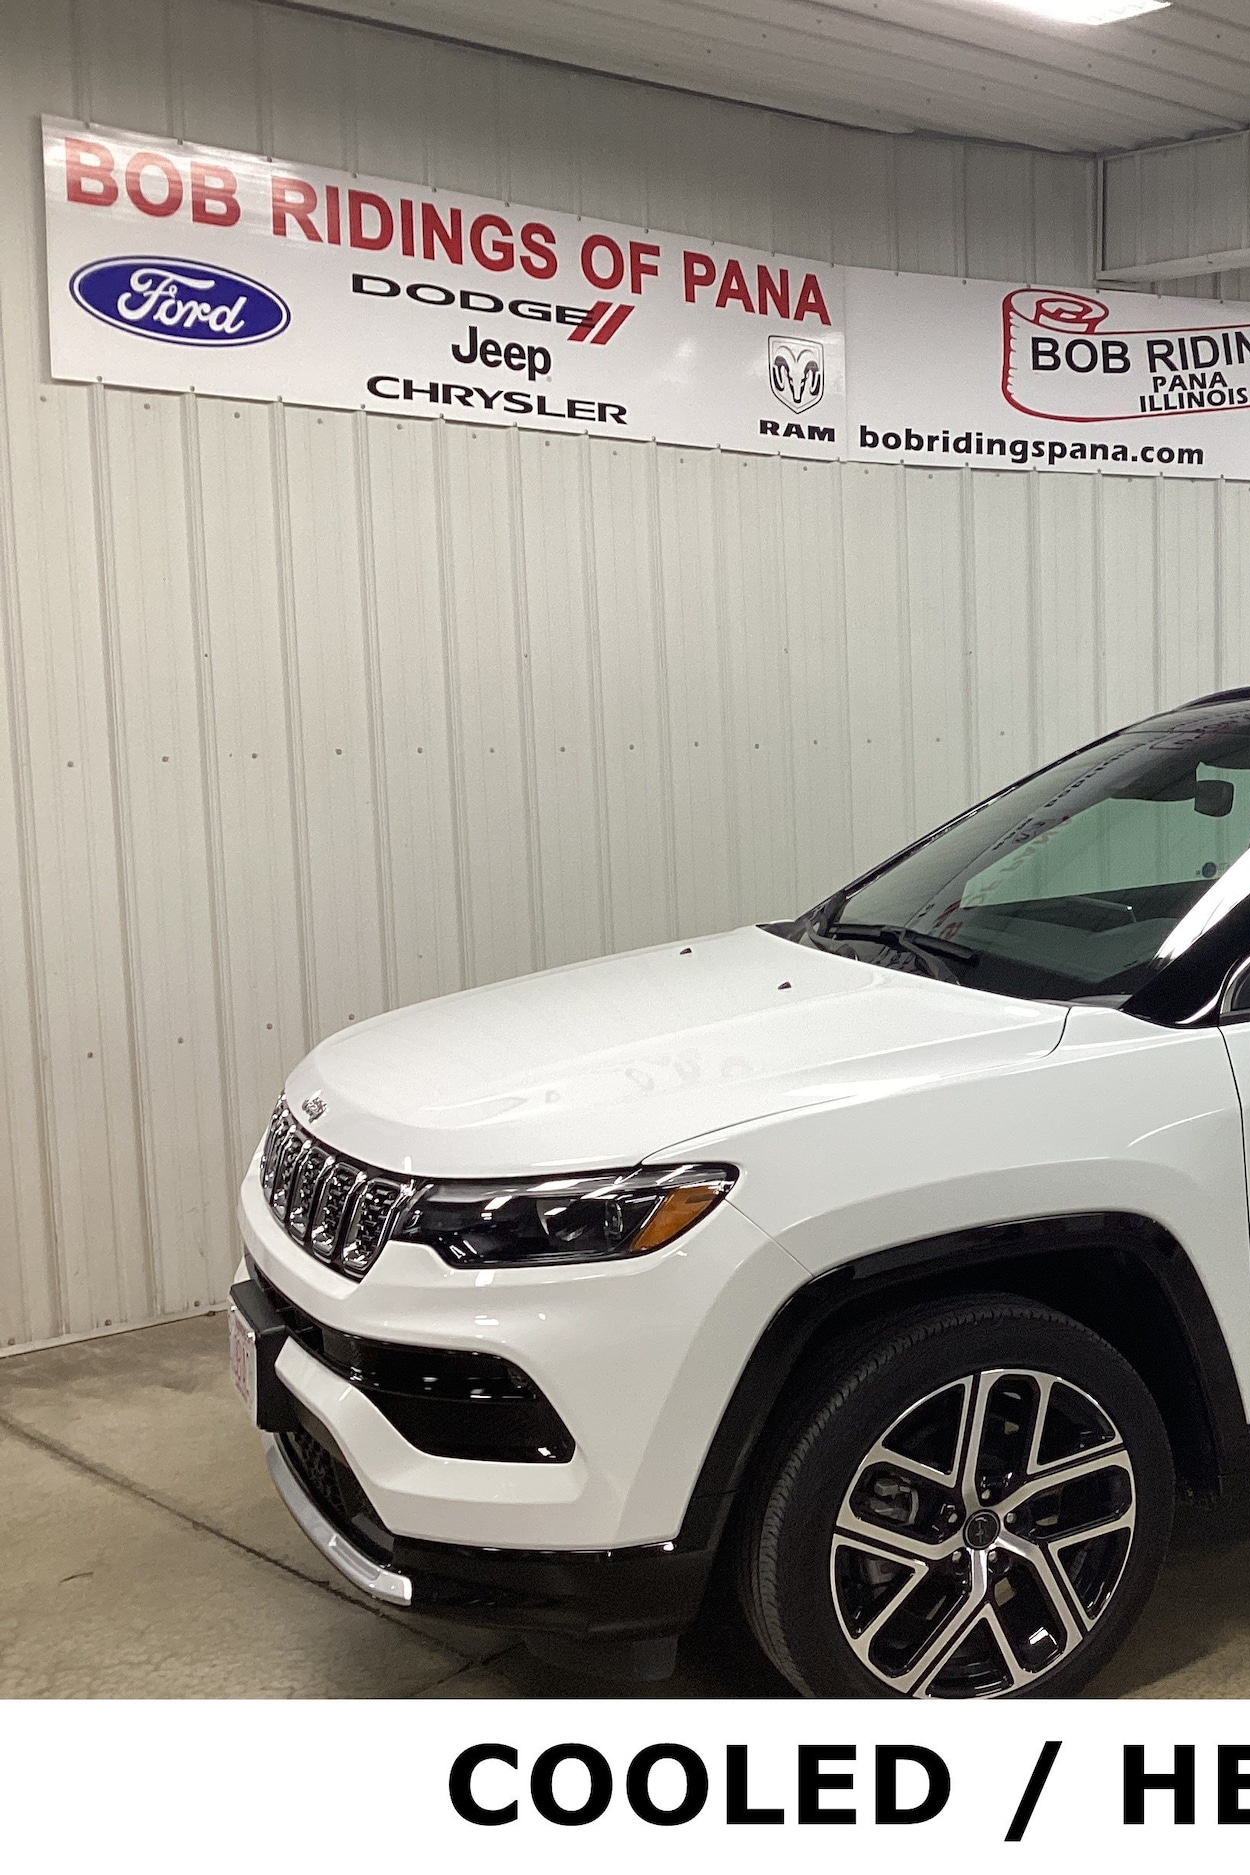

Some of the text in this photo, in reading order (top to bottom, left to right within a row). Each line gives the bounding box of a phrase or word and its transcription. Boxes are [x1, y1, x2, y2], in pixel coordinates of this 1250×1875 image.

[65, 136, 833, 328] BOB RIDINGS OF PANA
[117, 267, 246, 334] Ford
[351, 273, 599, 325] DODGE
[451, 325, 552, 382] Jeep
[1030, 336, 1131, 374] BOB
[366, 375, 629, 427] CHRYSLER
[1139, 387, 1249, 413] ILLINOIS
[1152, 372, 1228, 394] PANA
[758, 419, 837, 443] RAM
[859, 426, 1204, 466] bobridingspana.com
